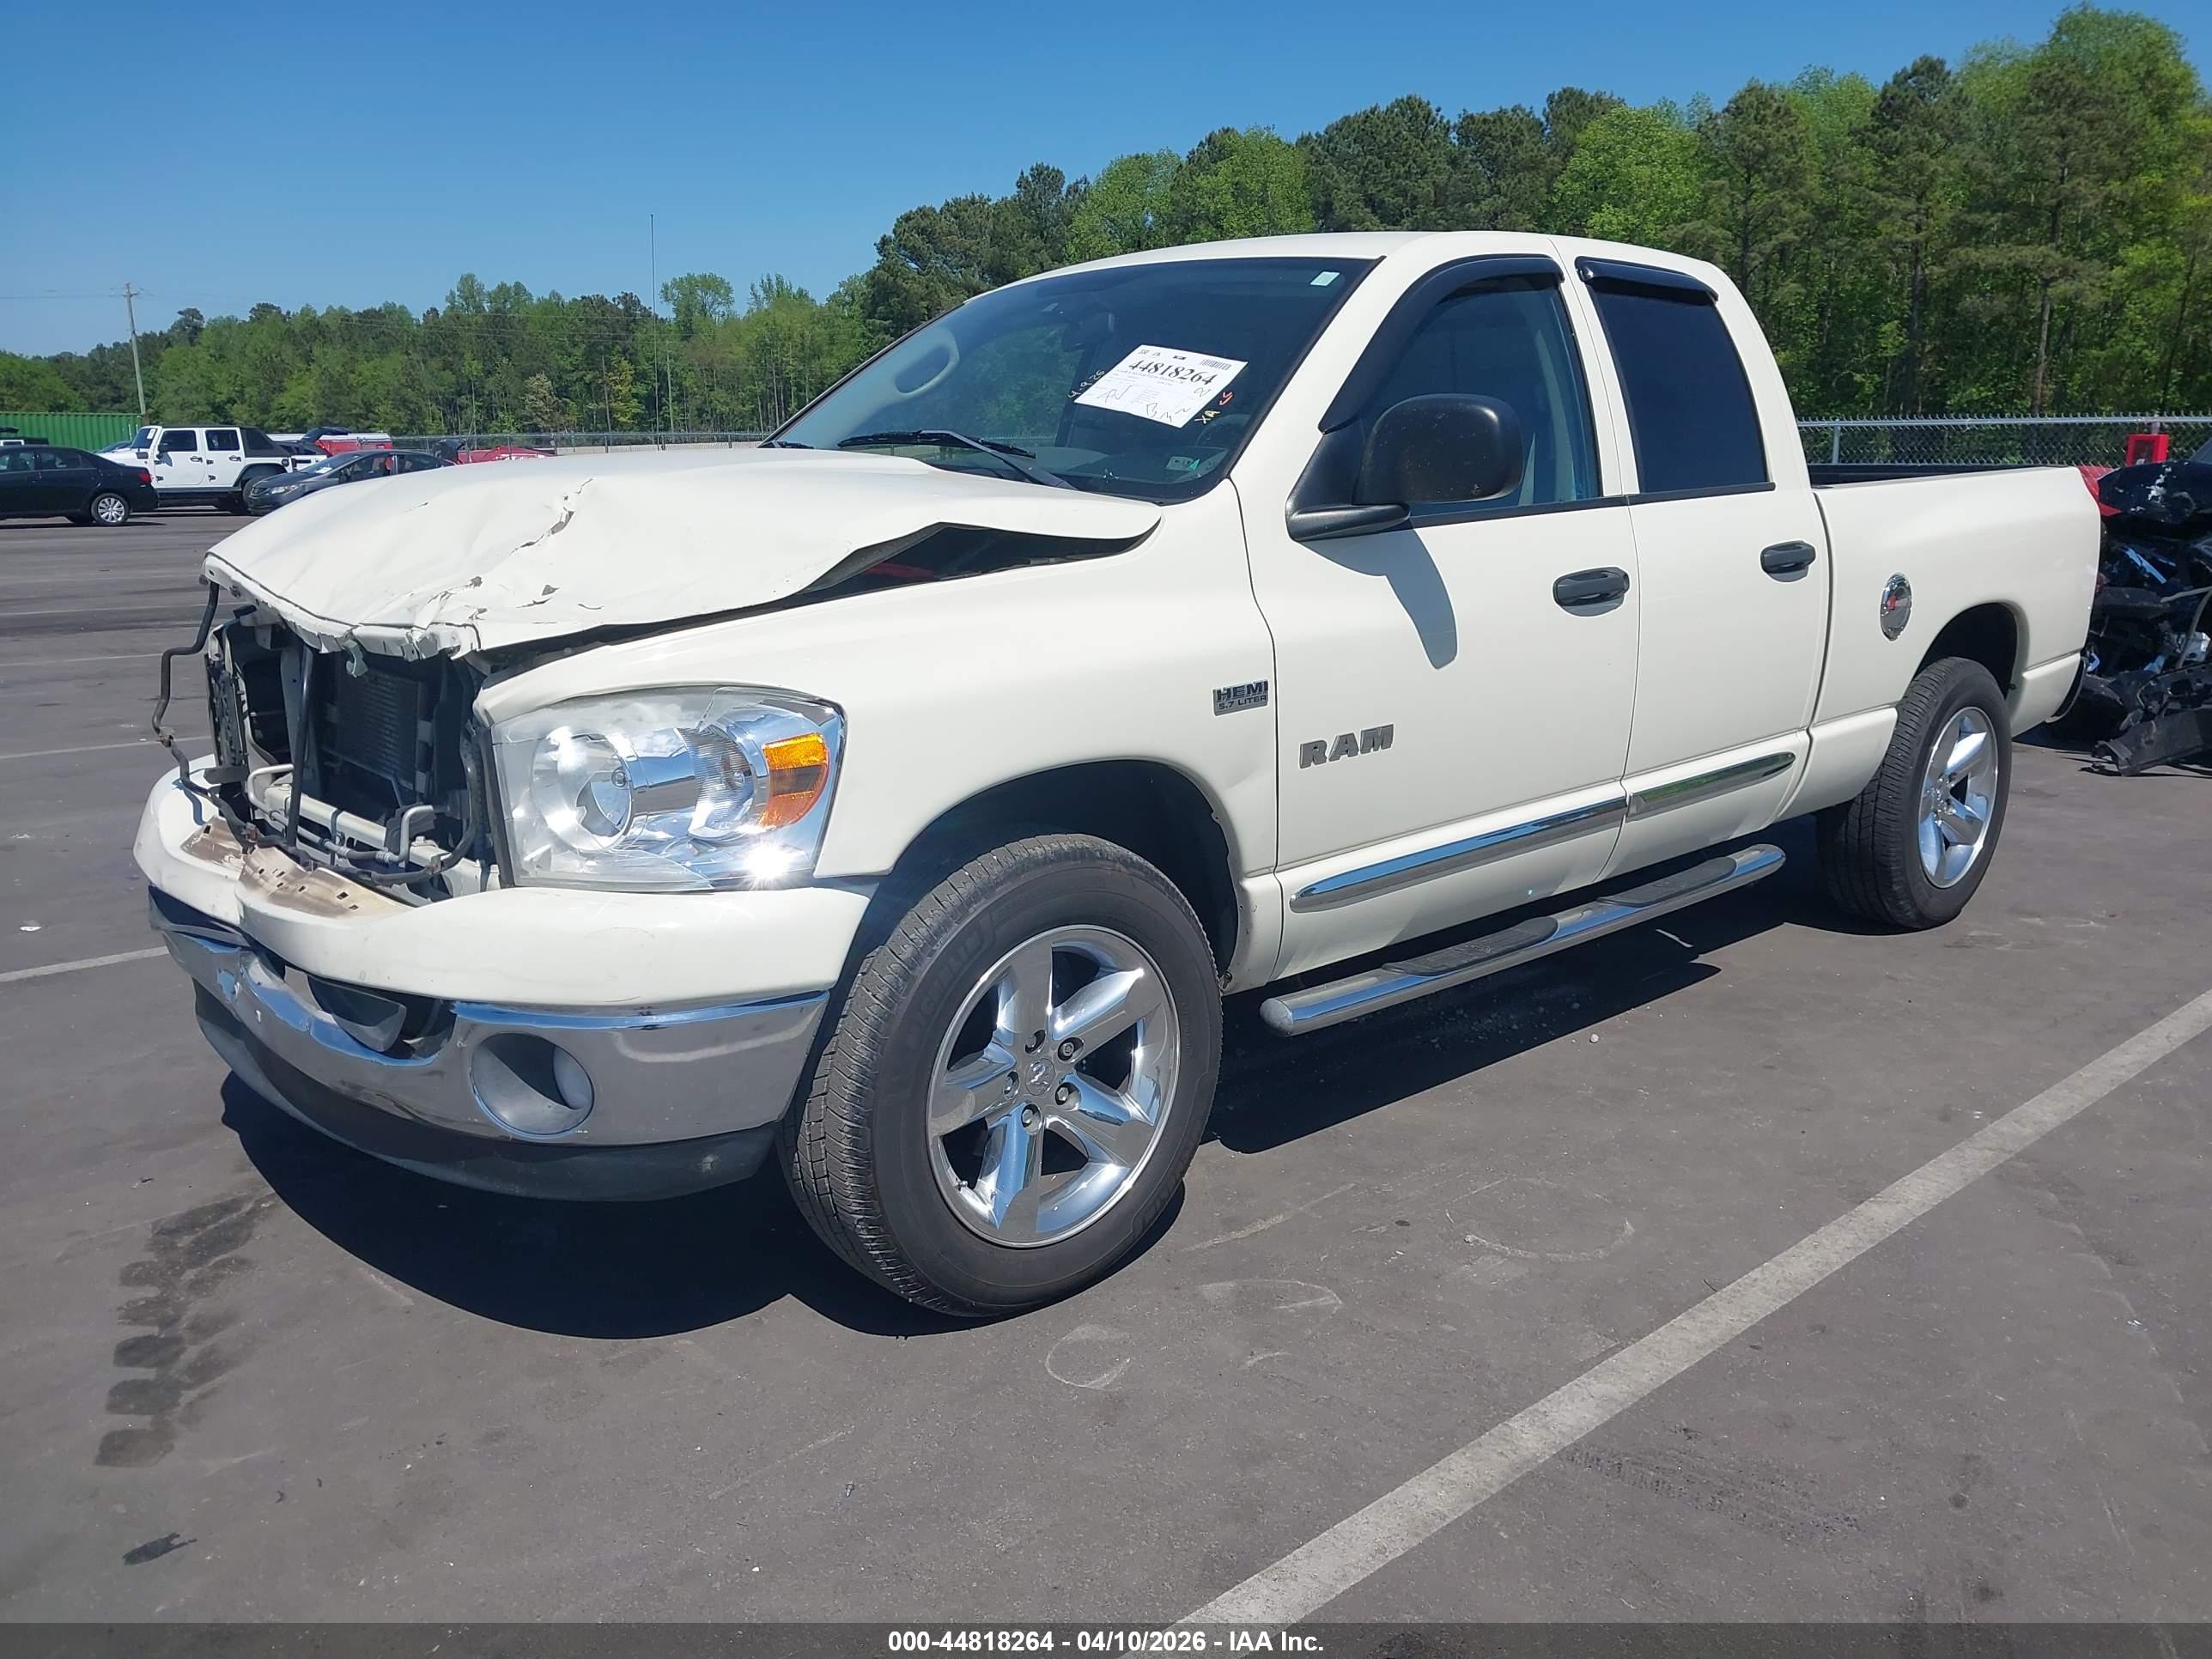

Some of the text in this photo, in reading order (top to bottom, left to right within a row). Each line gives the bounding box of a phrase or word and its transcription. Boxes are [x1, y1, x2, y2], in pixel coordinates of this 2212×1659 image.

[1128, 360, 1218, 385] 44818264
[1216, 680, 1268, 702] HEMI
[1218, 694, 1267, 710] 5.7 LITER
[1299, 723, 1394, 769] RAM
